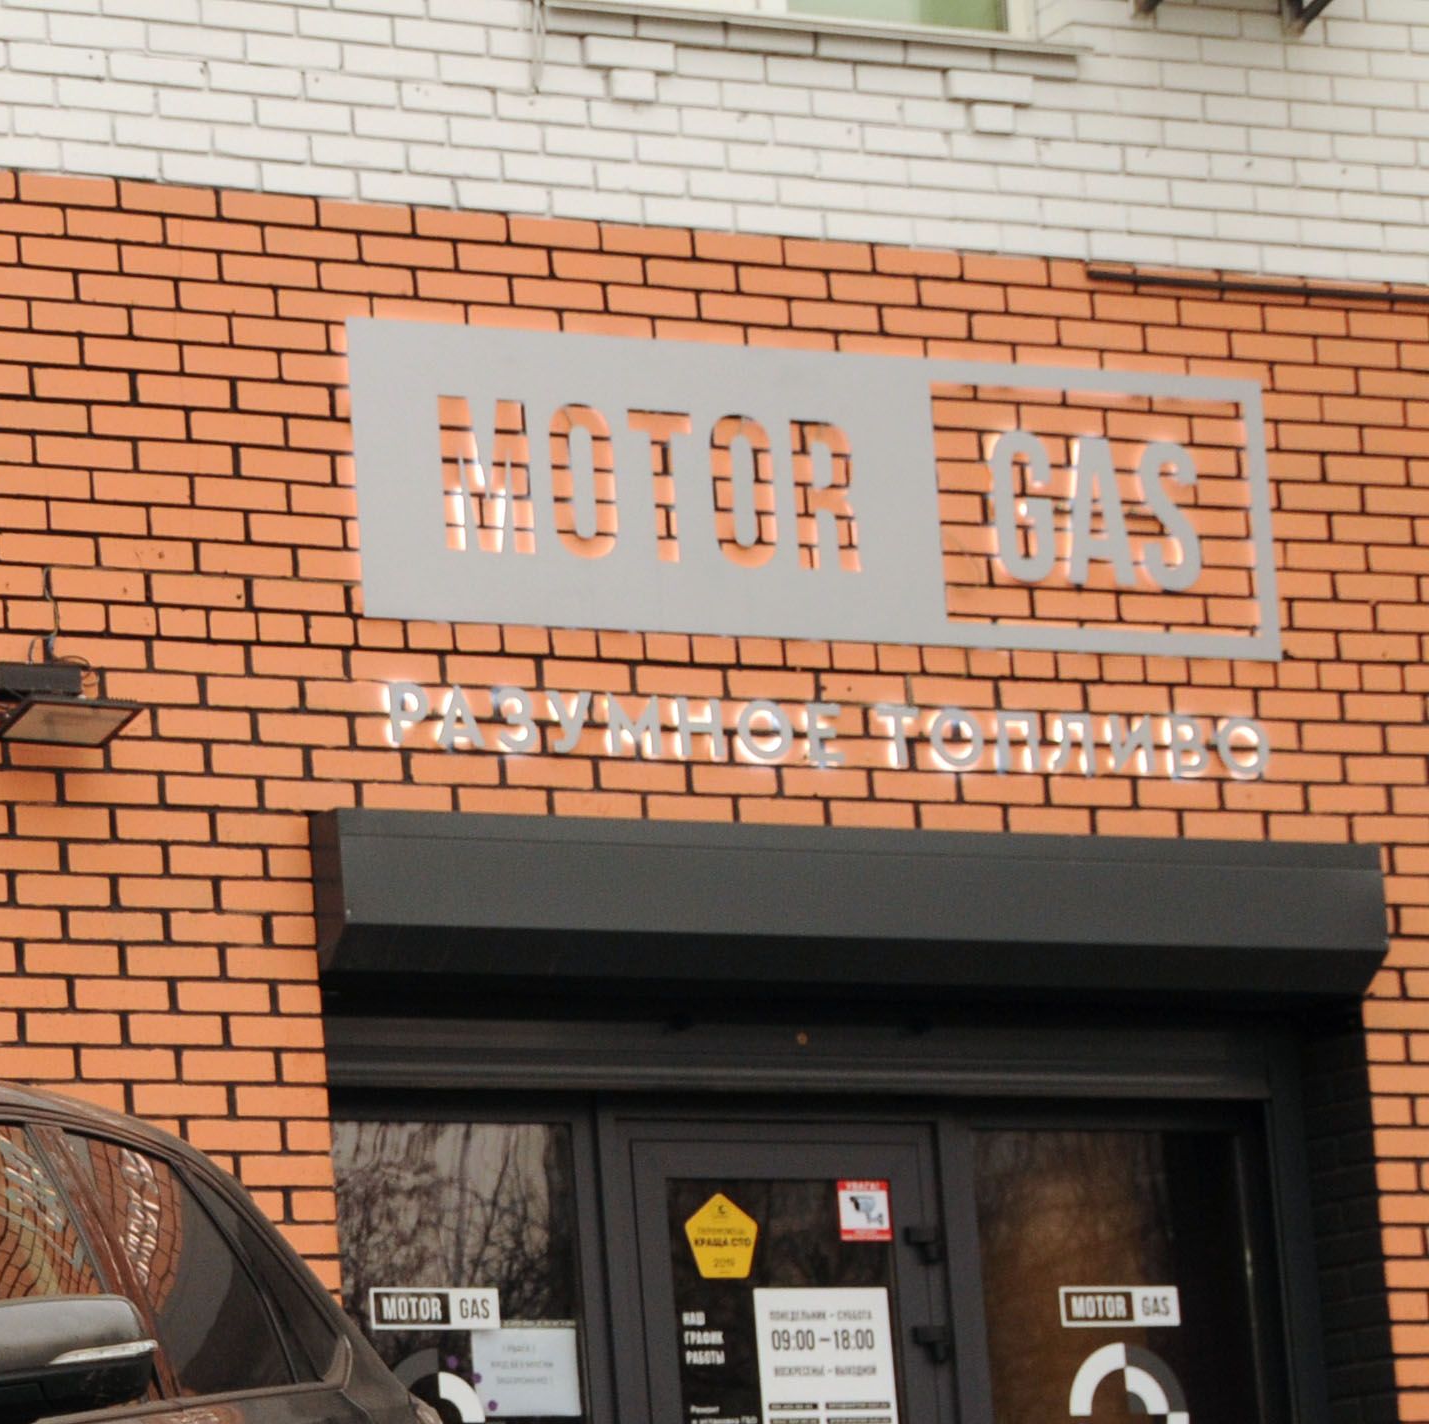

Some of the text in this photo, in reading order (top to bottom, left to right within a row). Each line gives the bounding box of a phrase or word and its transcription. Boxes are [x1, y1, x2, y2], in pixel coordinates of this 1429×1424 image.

[437, 394, 1203, 592] MOTOR GAS
[387, 680, 1270, 778] РАЗУМНОЕ ТОПЛИВО
[381, 1296, 491, 1321] MOTOR GAS
[836, 1309, 873, 1321] СУББОТА
[1070, 1294, 1170, 1319] MOTOR GAS
[682, 1311, 706, 1326] НАШ
[683, 1330, 725, 1345] ГРАФИК
[771, 1328, 816, 1351] 09:00
[833, 1328, 876, 1351] 18:00
[685, 1350, 726, 1365] РАБОТЫ
